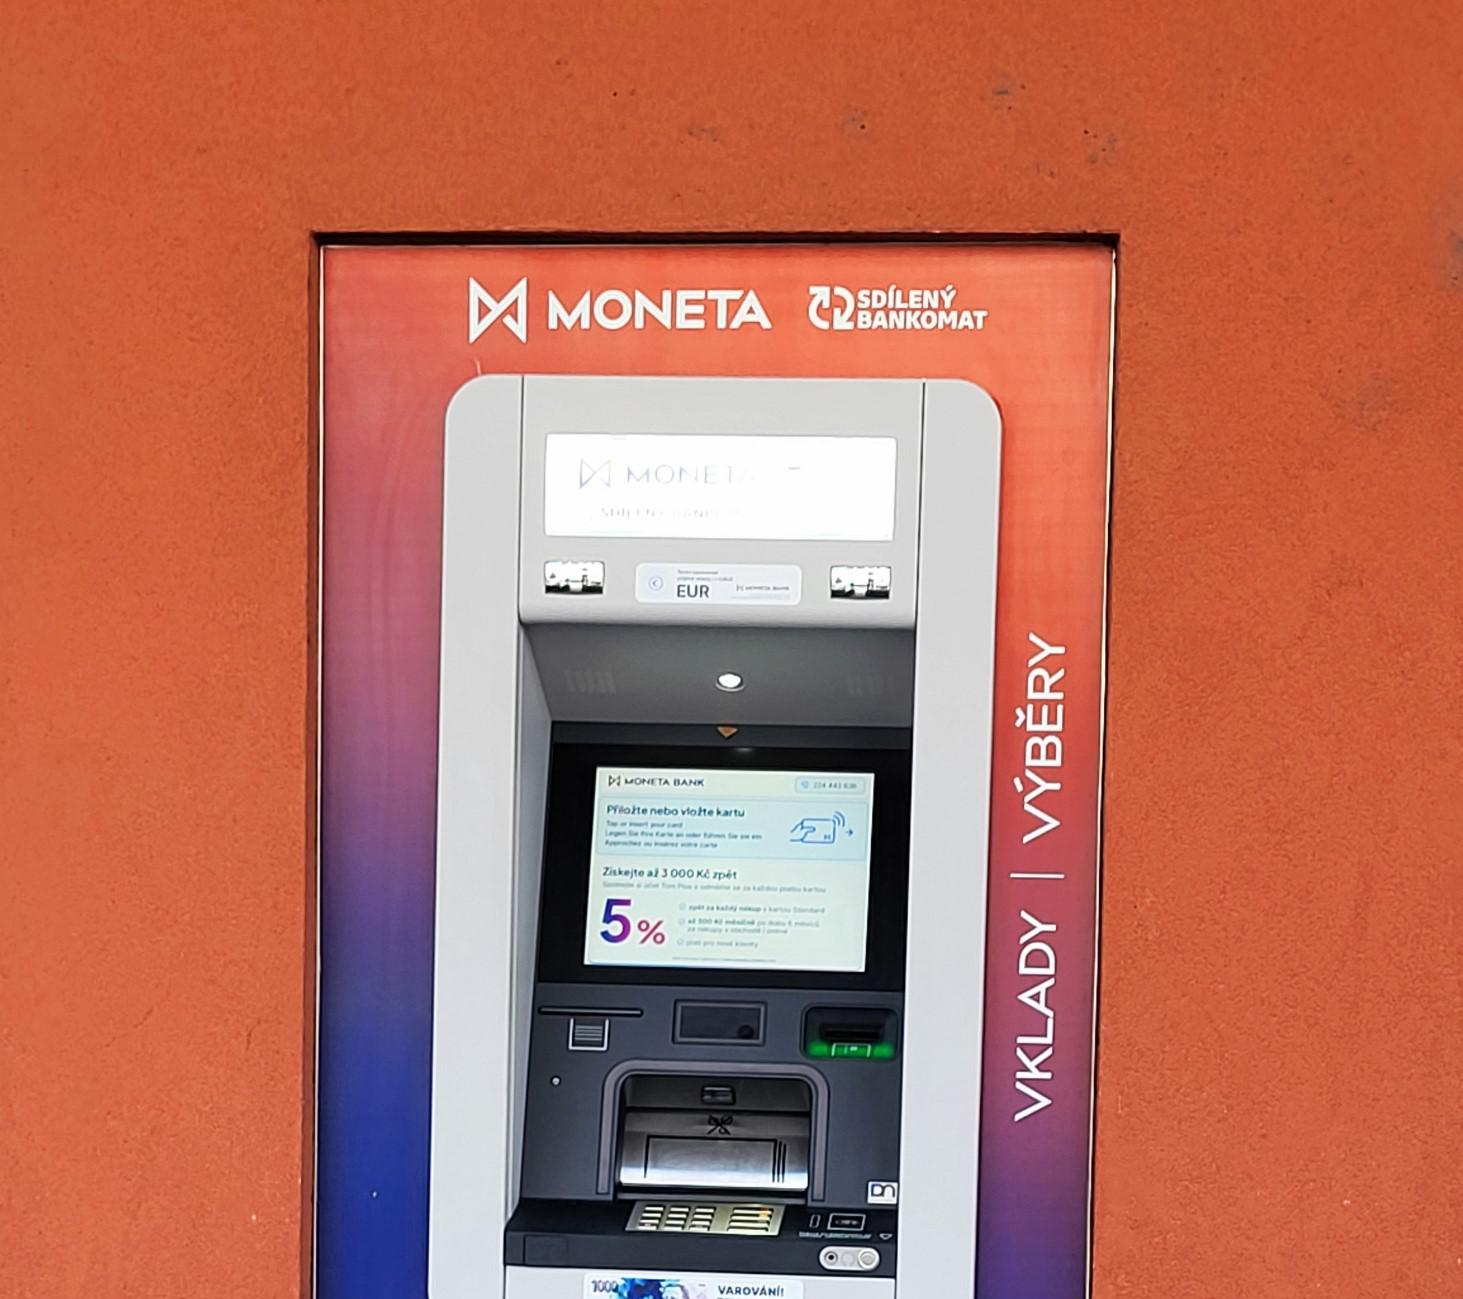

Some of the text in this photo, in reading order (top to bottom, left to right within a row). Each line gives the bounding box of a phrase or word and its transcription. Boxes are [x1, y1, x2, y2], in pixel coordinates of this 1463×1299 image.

[857, 283, 957, 309] SDÍLENÝ
[548, 289, 772, 330] MONETA
[856, 310, 988, 331] BANKOMAT
[676, 584, 710, 599] EUR
[1013, 632, 1066, 845] VÝBĚRY
[624, 777, 705, 787] MONETA BANK
[606, 804, 745, 818] Přiložte nebo vložte kartu
[602, 866, 737, 881] Získejte až 3 000 Kč zpět
[1014, 909, 1057, 1122] VKLADY
[717, 1284, 785, 1298] VAROVÁNÍ!
